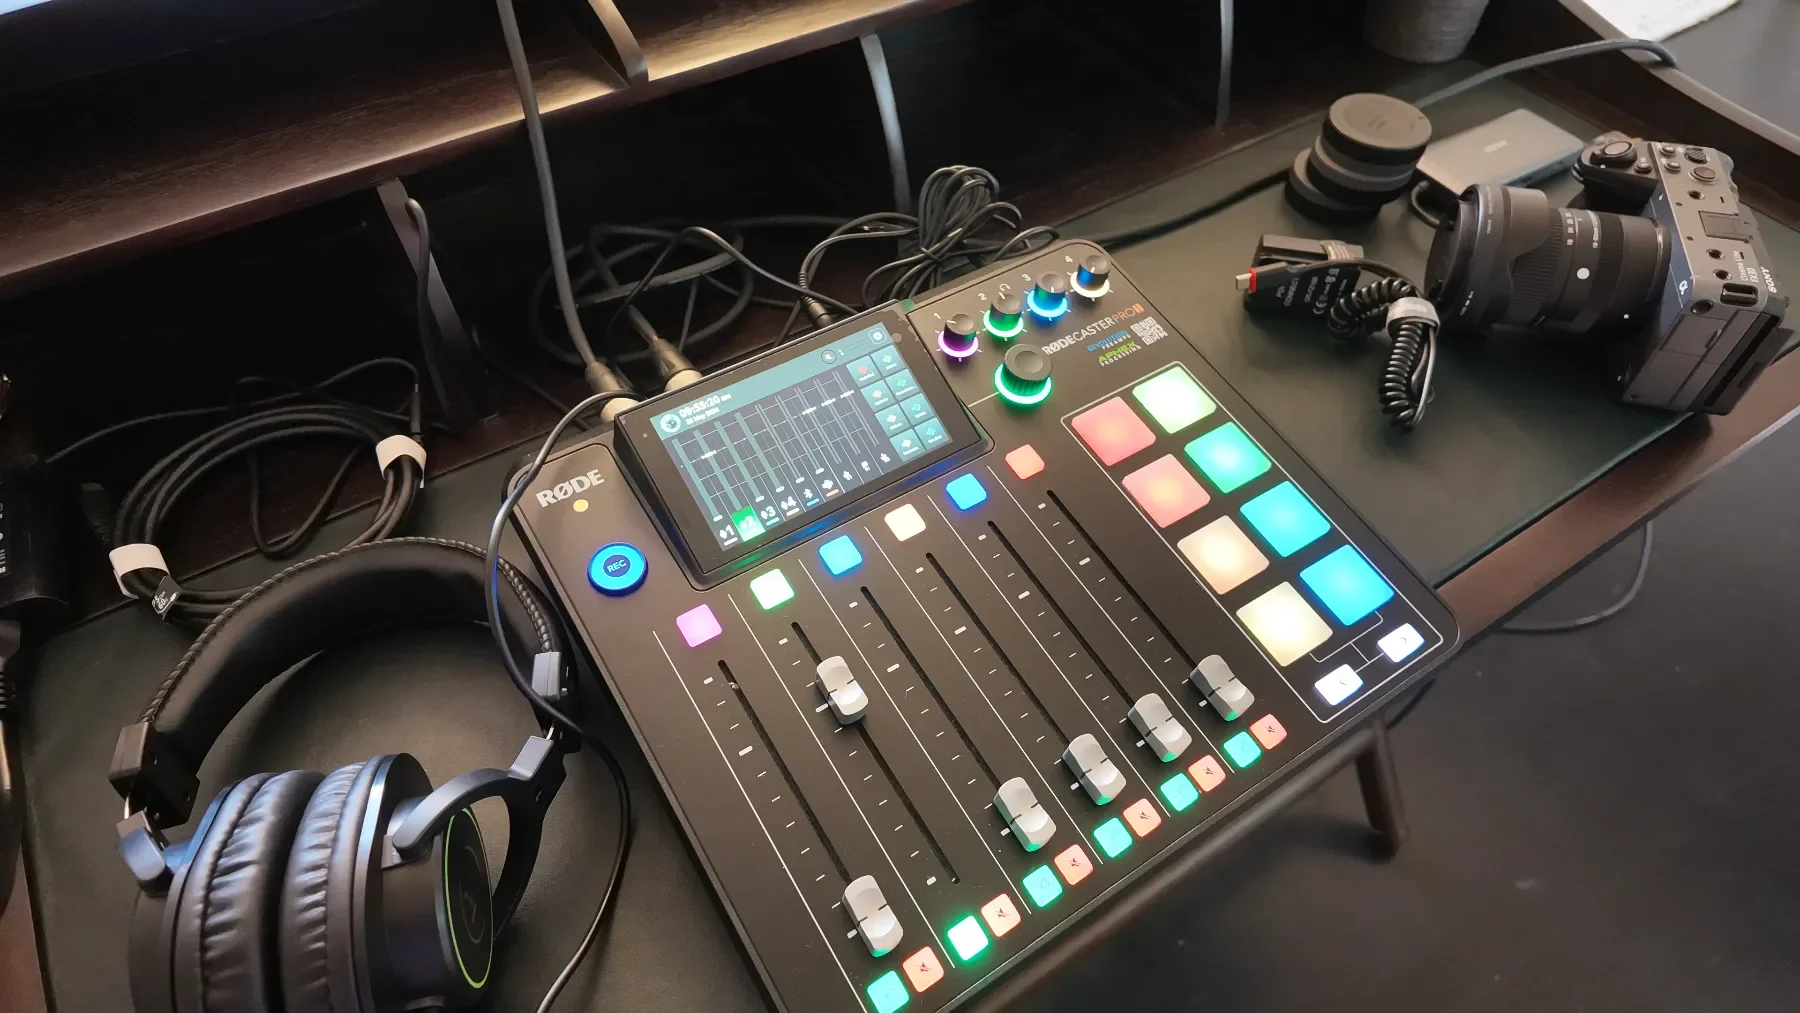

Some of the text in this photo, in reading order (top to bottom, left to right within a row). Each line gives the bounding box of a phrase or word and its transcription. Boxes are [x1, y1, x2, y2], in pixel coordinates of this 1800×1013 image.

[1064, 255, 1074, 263] 4
[1021, 273, 1032, 282] 3
[1760, 265, 1778, 294] SONY
[978, 292, 988, 301] 2
[606, 559, 628, 573] REC
